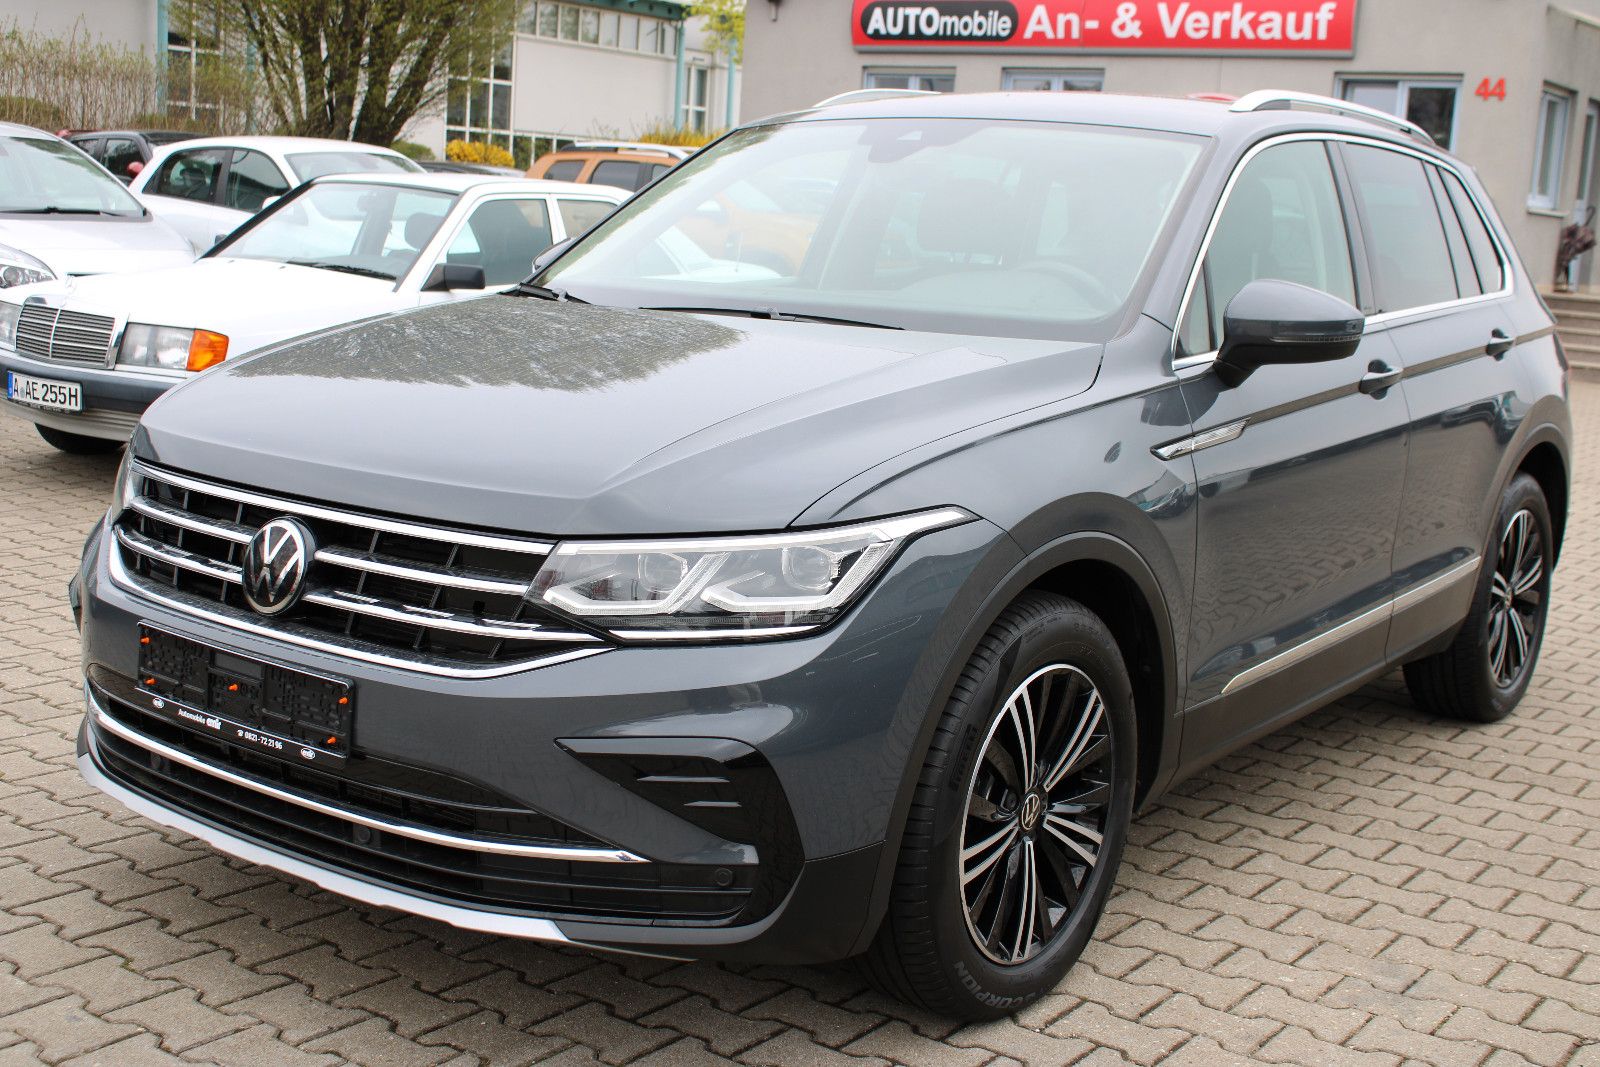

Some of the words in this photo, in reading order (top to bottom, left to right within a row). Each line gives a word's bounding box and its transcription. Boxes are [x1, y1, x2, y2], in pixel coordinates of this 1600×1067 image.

[867, 6, 1012, 36] AUTOmobile
[1023, 3, 1099, 39] An-
[1110, 2, 1142, 39] &
[1156, 1, 1337, 41] Verkauf
[1474, 77, 1506, 101] 44
[14, 377, 20, 397] A
[26, 380, 40, 400] AE
[41, 383, 79, 407] 255H
